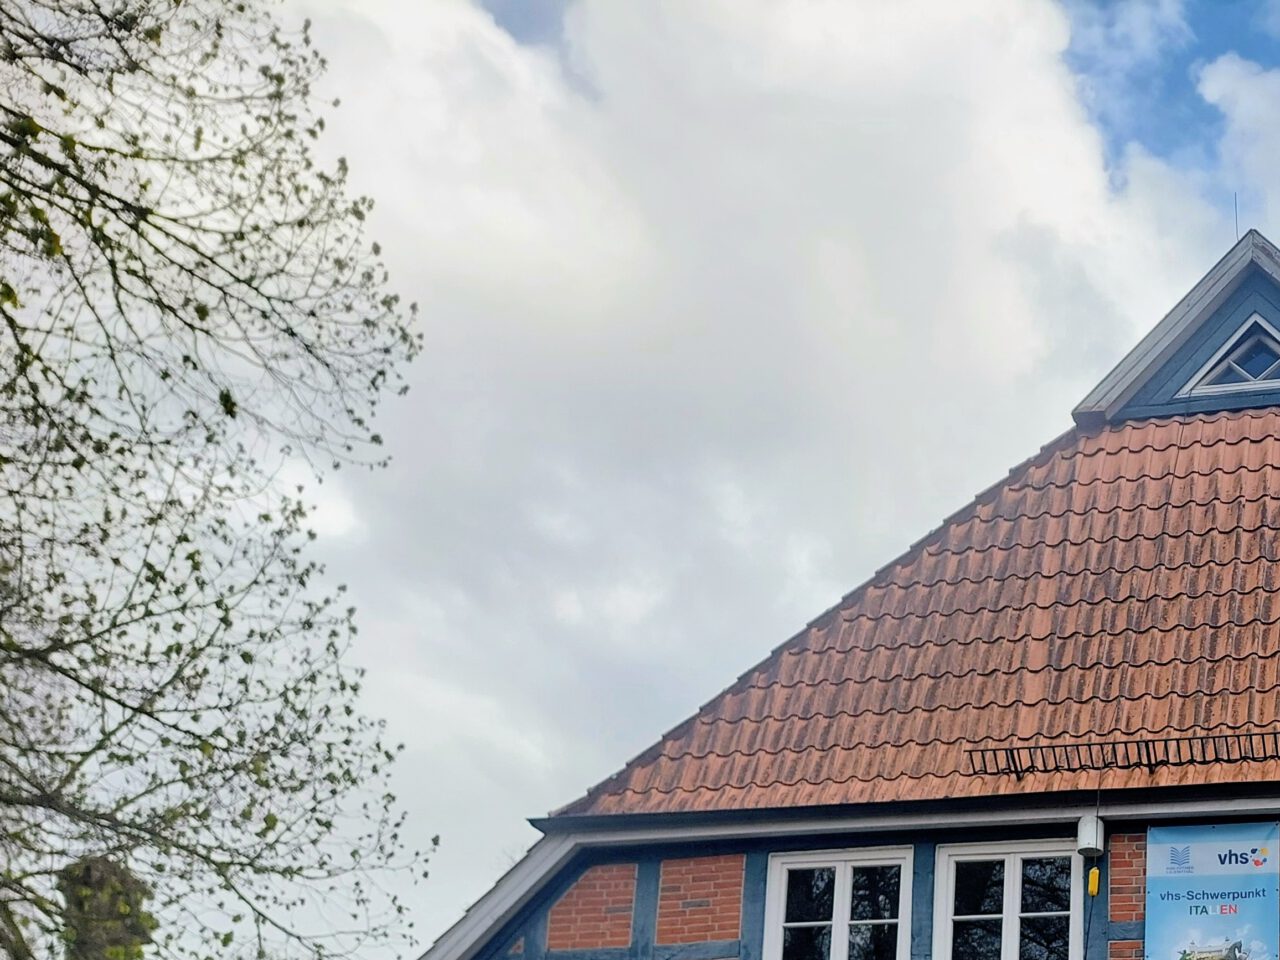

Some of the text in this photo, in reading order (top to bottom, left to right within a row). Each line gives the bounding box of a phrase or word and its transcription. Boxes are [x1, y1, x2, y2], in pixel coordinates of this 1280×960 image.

[1218, 849, 1249, 865] vhs
[1160, 888, 1266, 902] vhs-Schwerpunkt
[1189, 904, 1237, 916] ITALIEN
